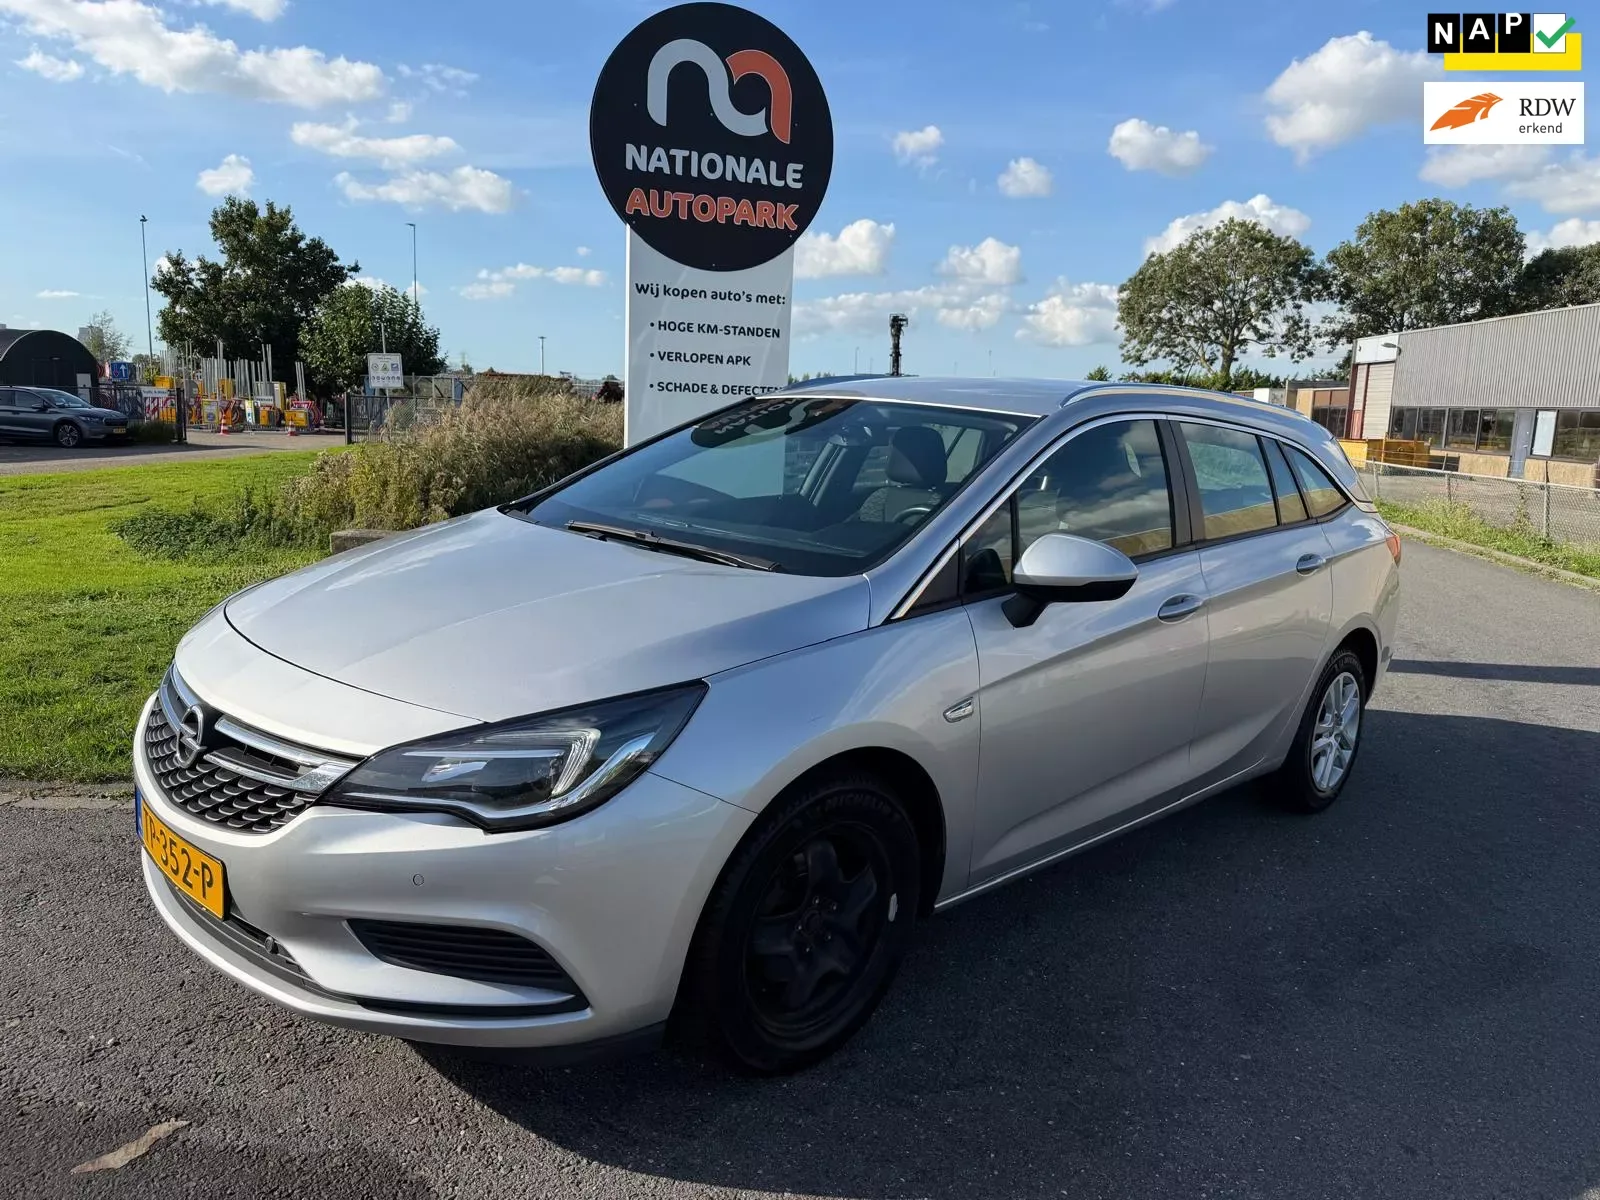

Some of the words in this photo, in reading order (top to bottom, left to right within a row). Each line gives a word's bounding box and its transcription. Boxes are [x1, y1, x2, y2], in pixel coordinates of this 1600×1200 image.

[625, 143, 804, 188] NATIONALE
[625, 187, 800, 230] AUTOPARK
[635, 282, 660, 298] Wij
[663, 284, 707, 300] kopen
[755, 293, 786, 305] met:
[658, 320, 694, 333] HOGE
[697, 323, 781, 339] KM-STANDEN
[658, 350, 724, 365] VERLOPEN
[726, 355, 751, 366] APK
[657, 381, 708, 394] SCHADE
[709, 384, 719, 395] &
[142, 806, 214, 900] TP-352-P
